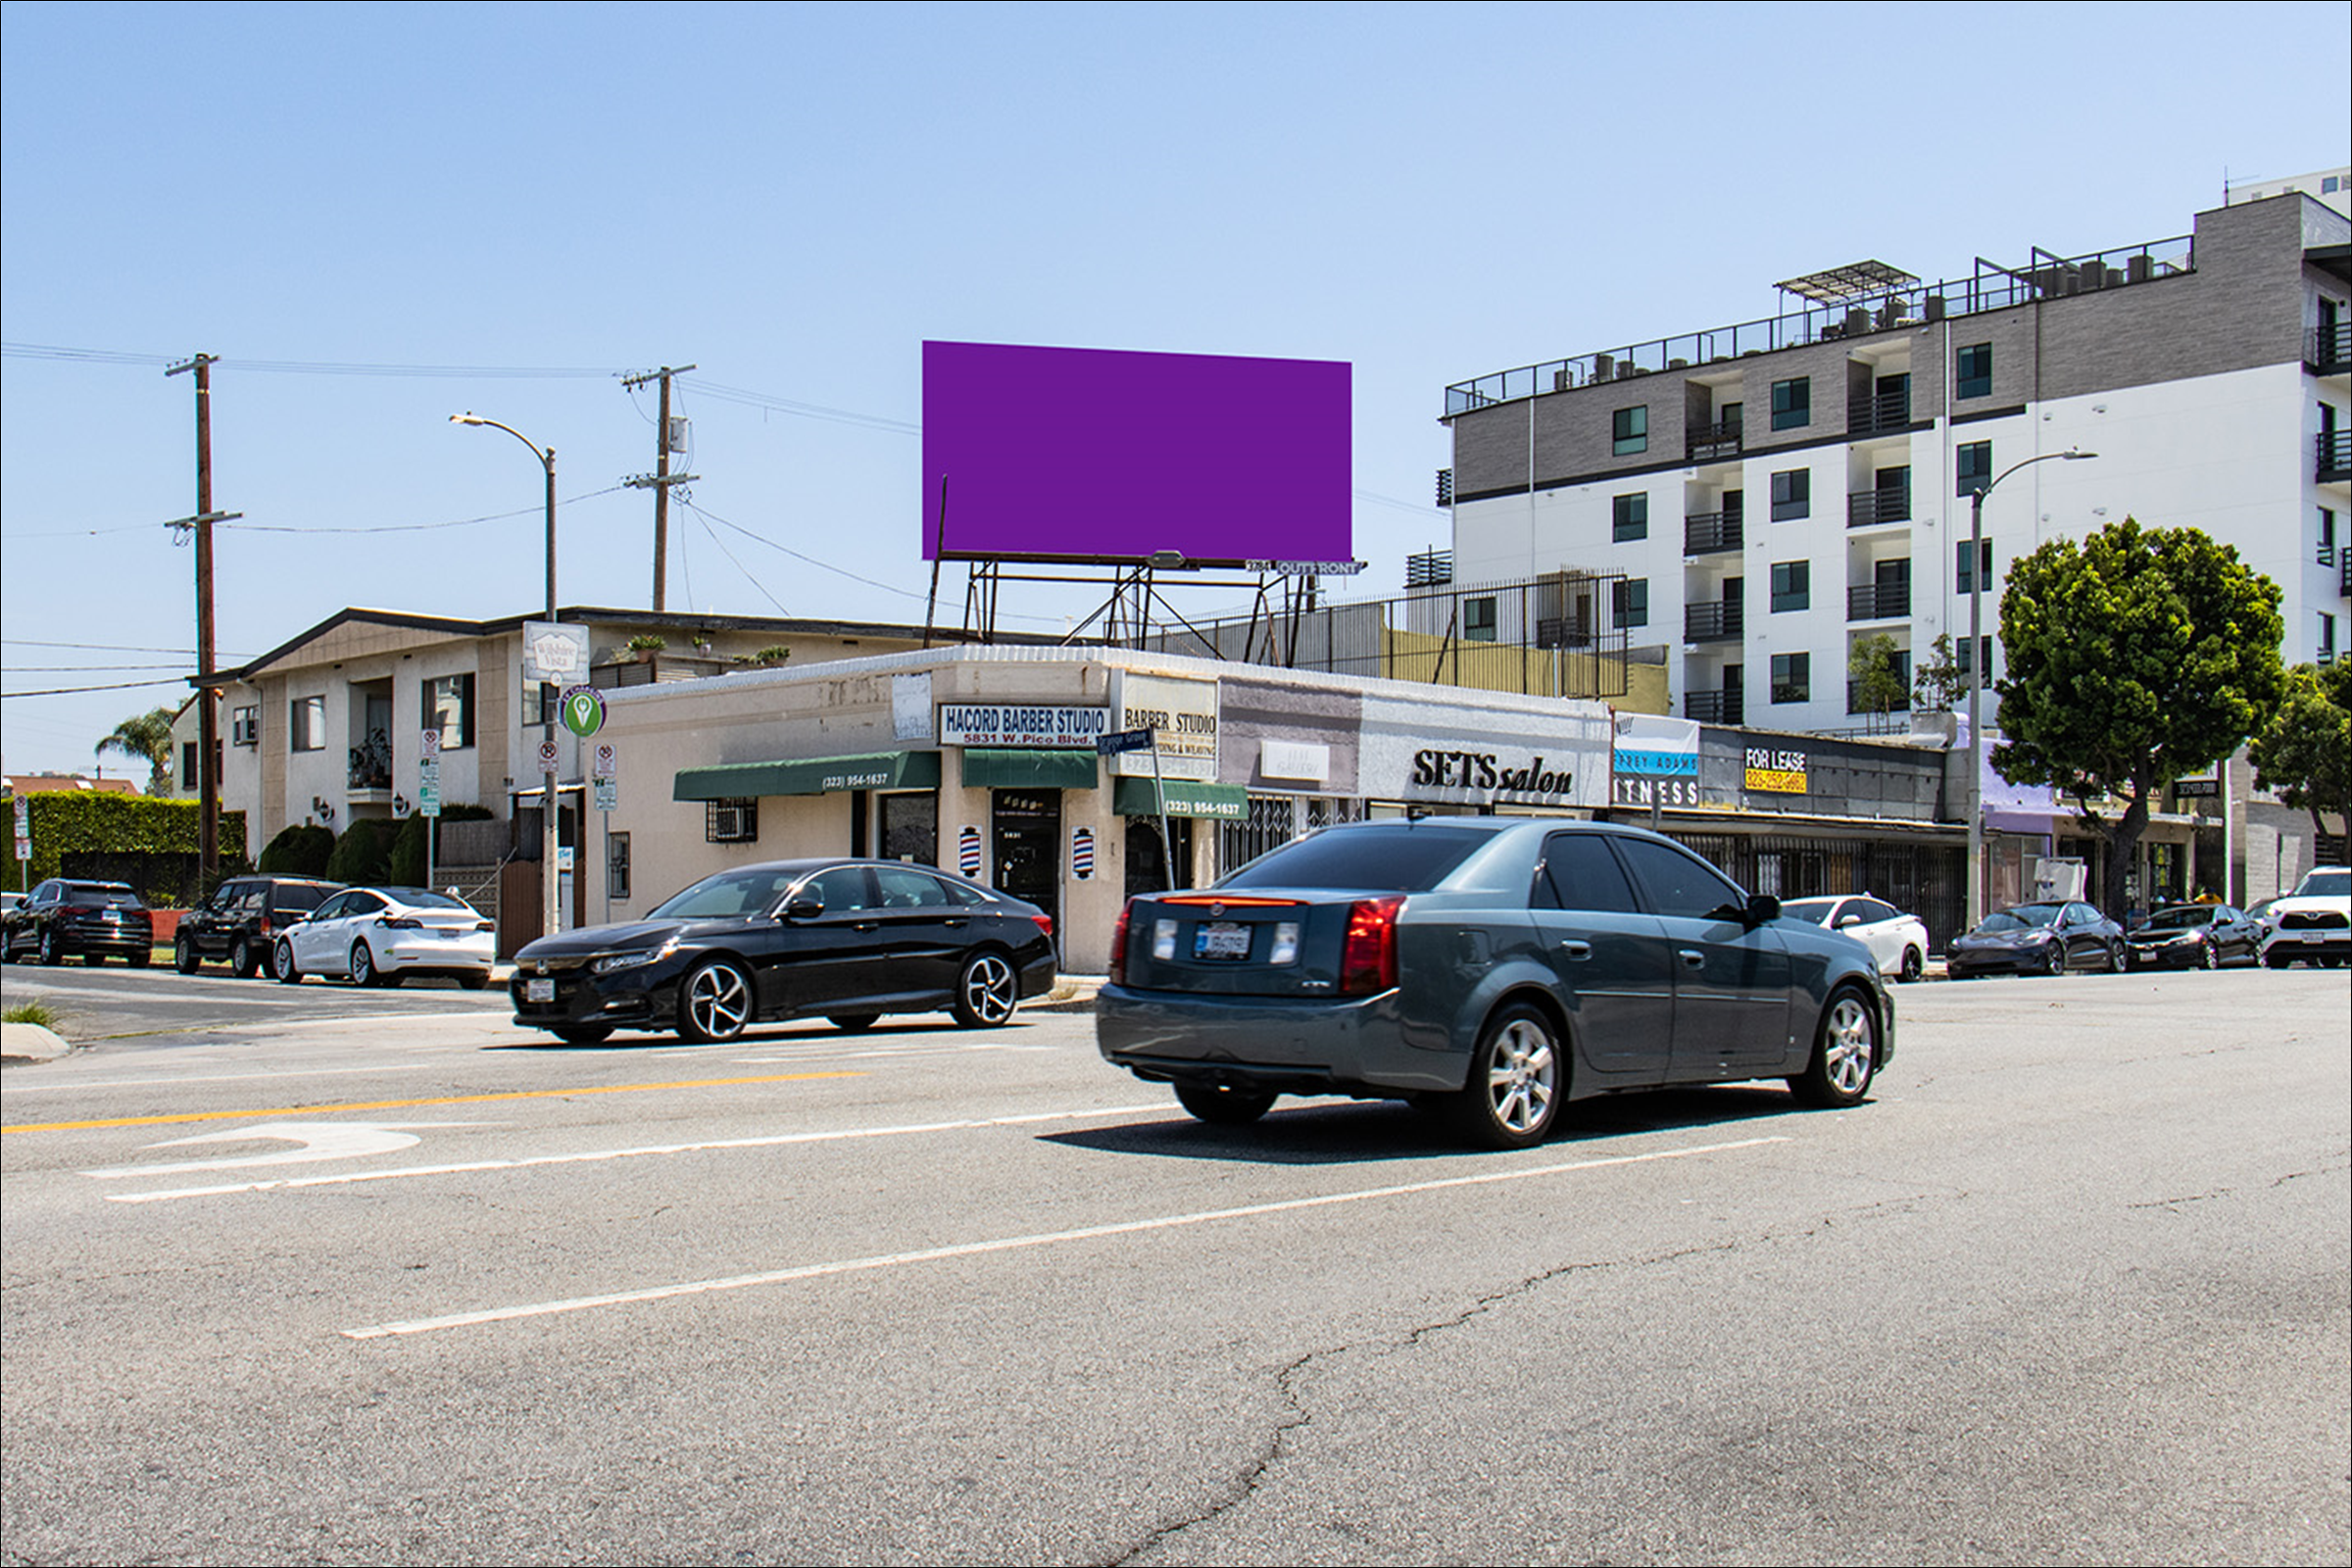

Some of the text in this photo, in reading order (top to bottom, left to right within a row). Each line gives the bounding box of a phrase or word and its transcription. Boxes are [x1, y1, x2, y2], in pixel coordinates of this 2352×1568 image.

[1279, 562, 1358, 574] OUTFRONT
[946, 708, 1104, 734] HACORD BARBER STUDIO
[1124, 708, 1216, 734] BARBER STUDIO
[963, 733, 997, 744] 5831
[1057, 735, 1093, 745] Blvd.
[1614, 754, 1697, 770] FREY ADAMS
[1745, 748, 1806, 772] FOR LEASE
[822, 772, 888, 790] (323) 954-1637
[1412, 749, 1573, 795] SETS salon
[1165, 800, 1240, 815] (323) 954-1637
